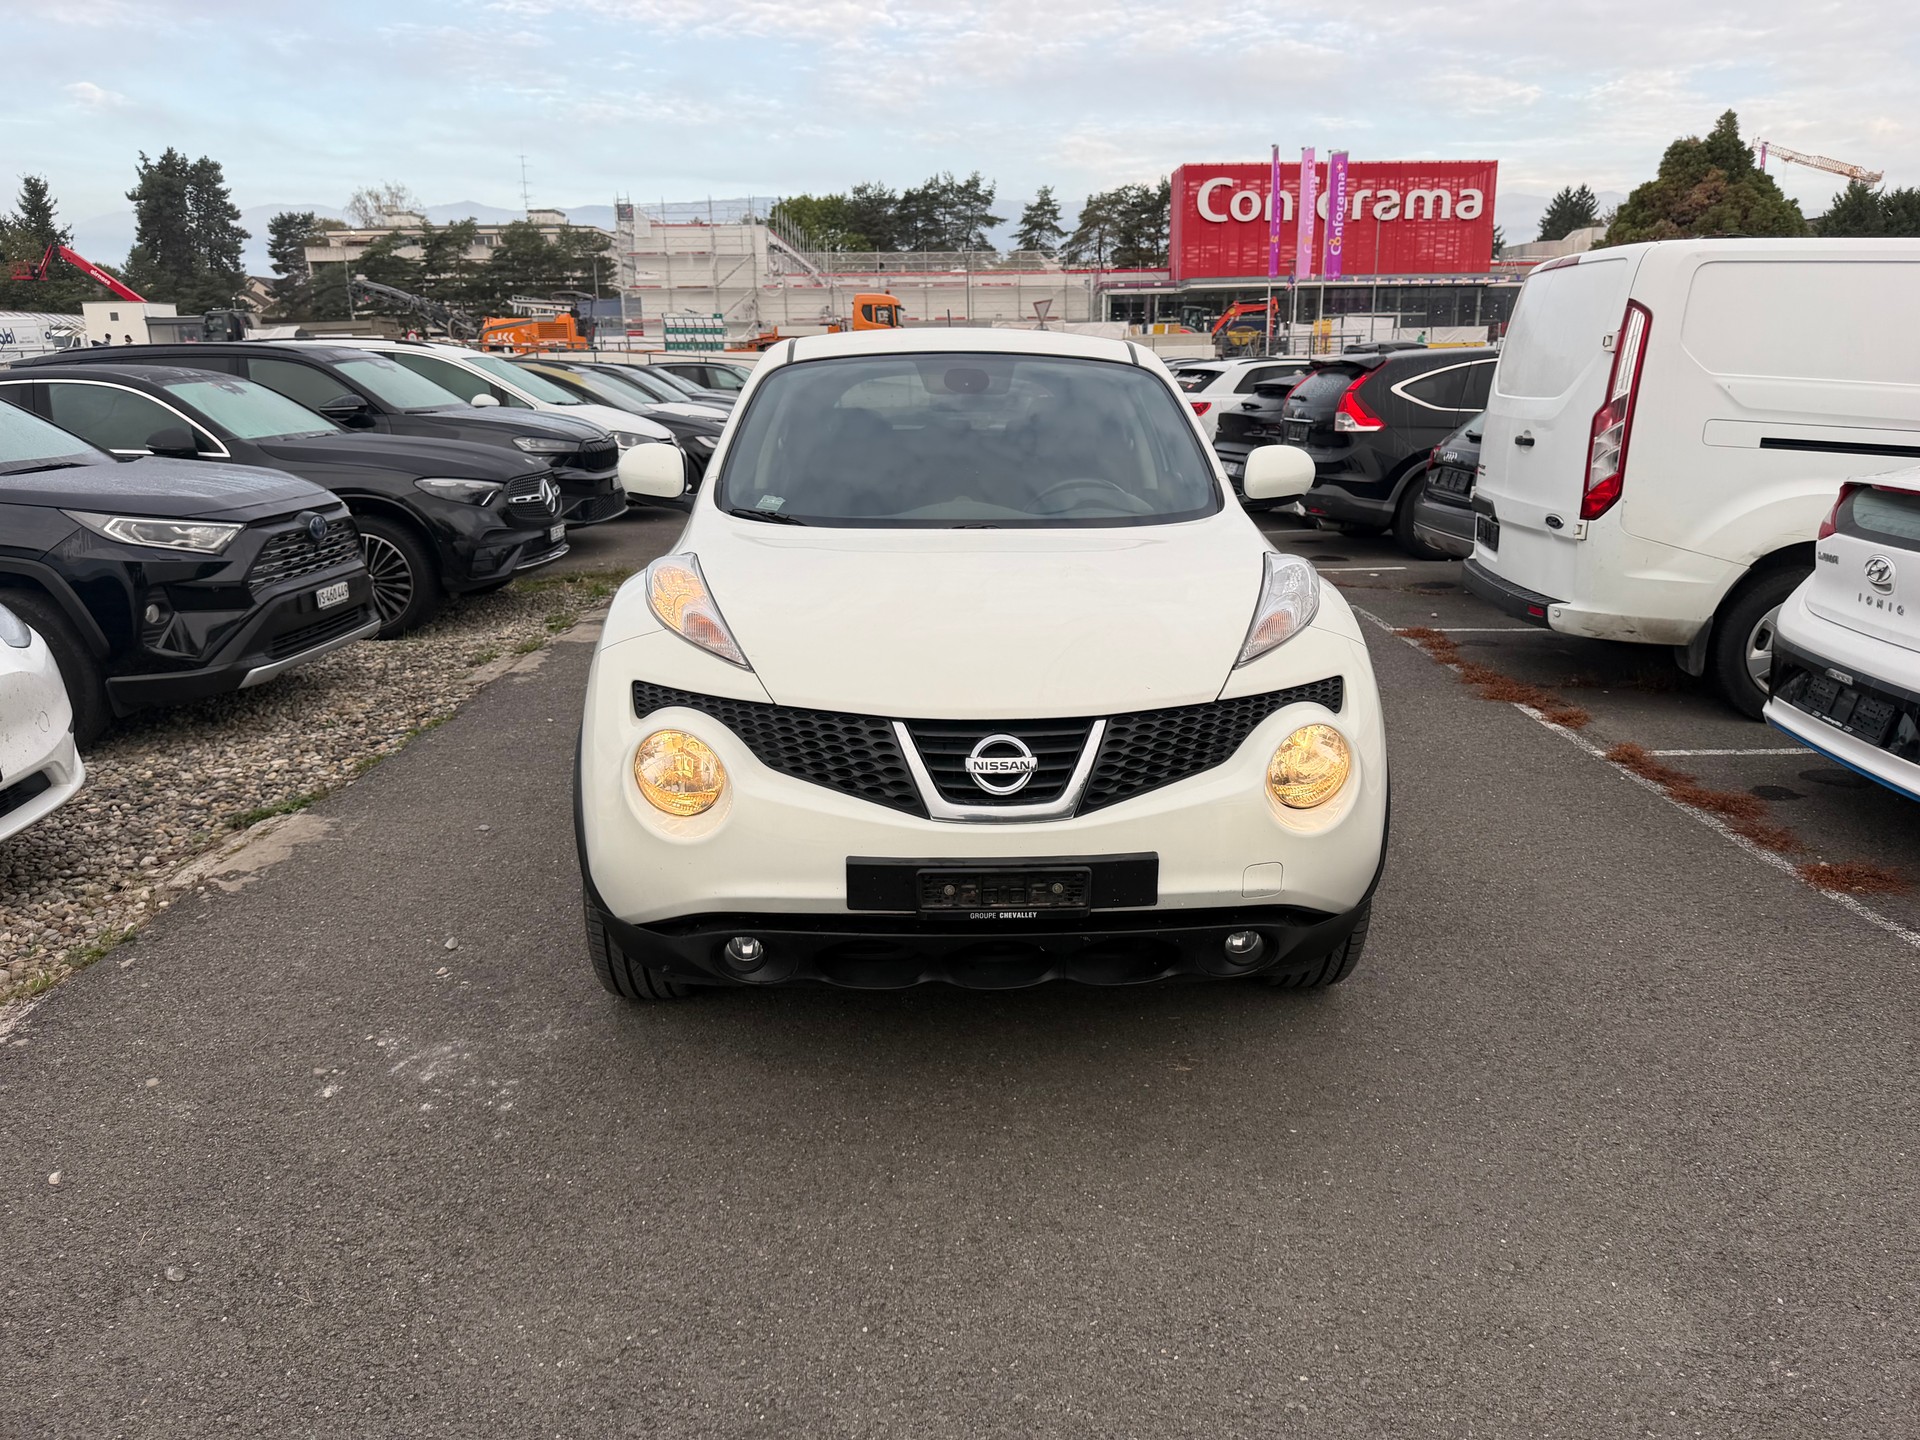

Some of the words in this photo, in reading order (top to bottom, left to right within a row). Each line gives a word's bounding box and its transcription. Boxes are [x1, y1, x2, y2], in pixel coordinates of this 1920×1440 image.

[1197, 177, 1484, 223] Conrama
[1858, 592, 1904, 616] IONIQ
[973, 760, 1030, 771] NISSAN
[970, 912, 997, 920] GROUPE
[999, 911, 1038, 919] CHEVALLEY
